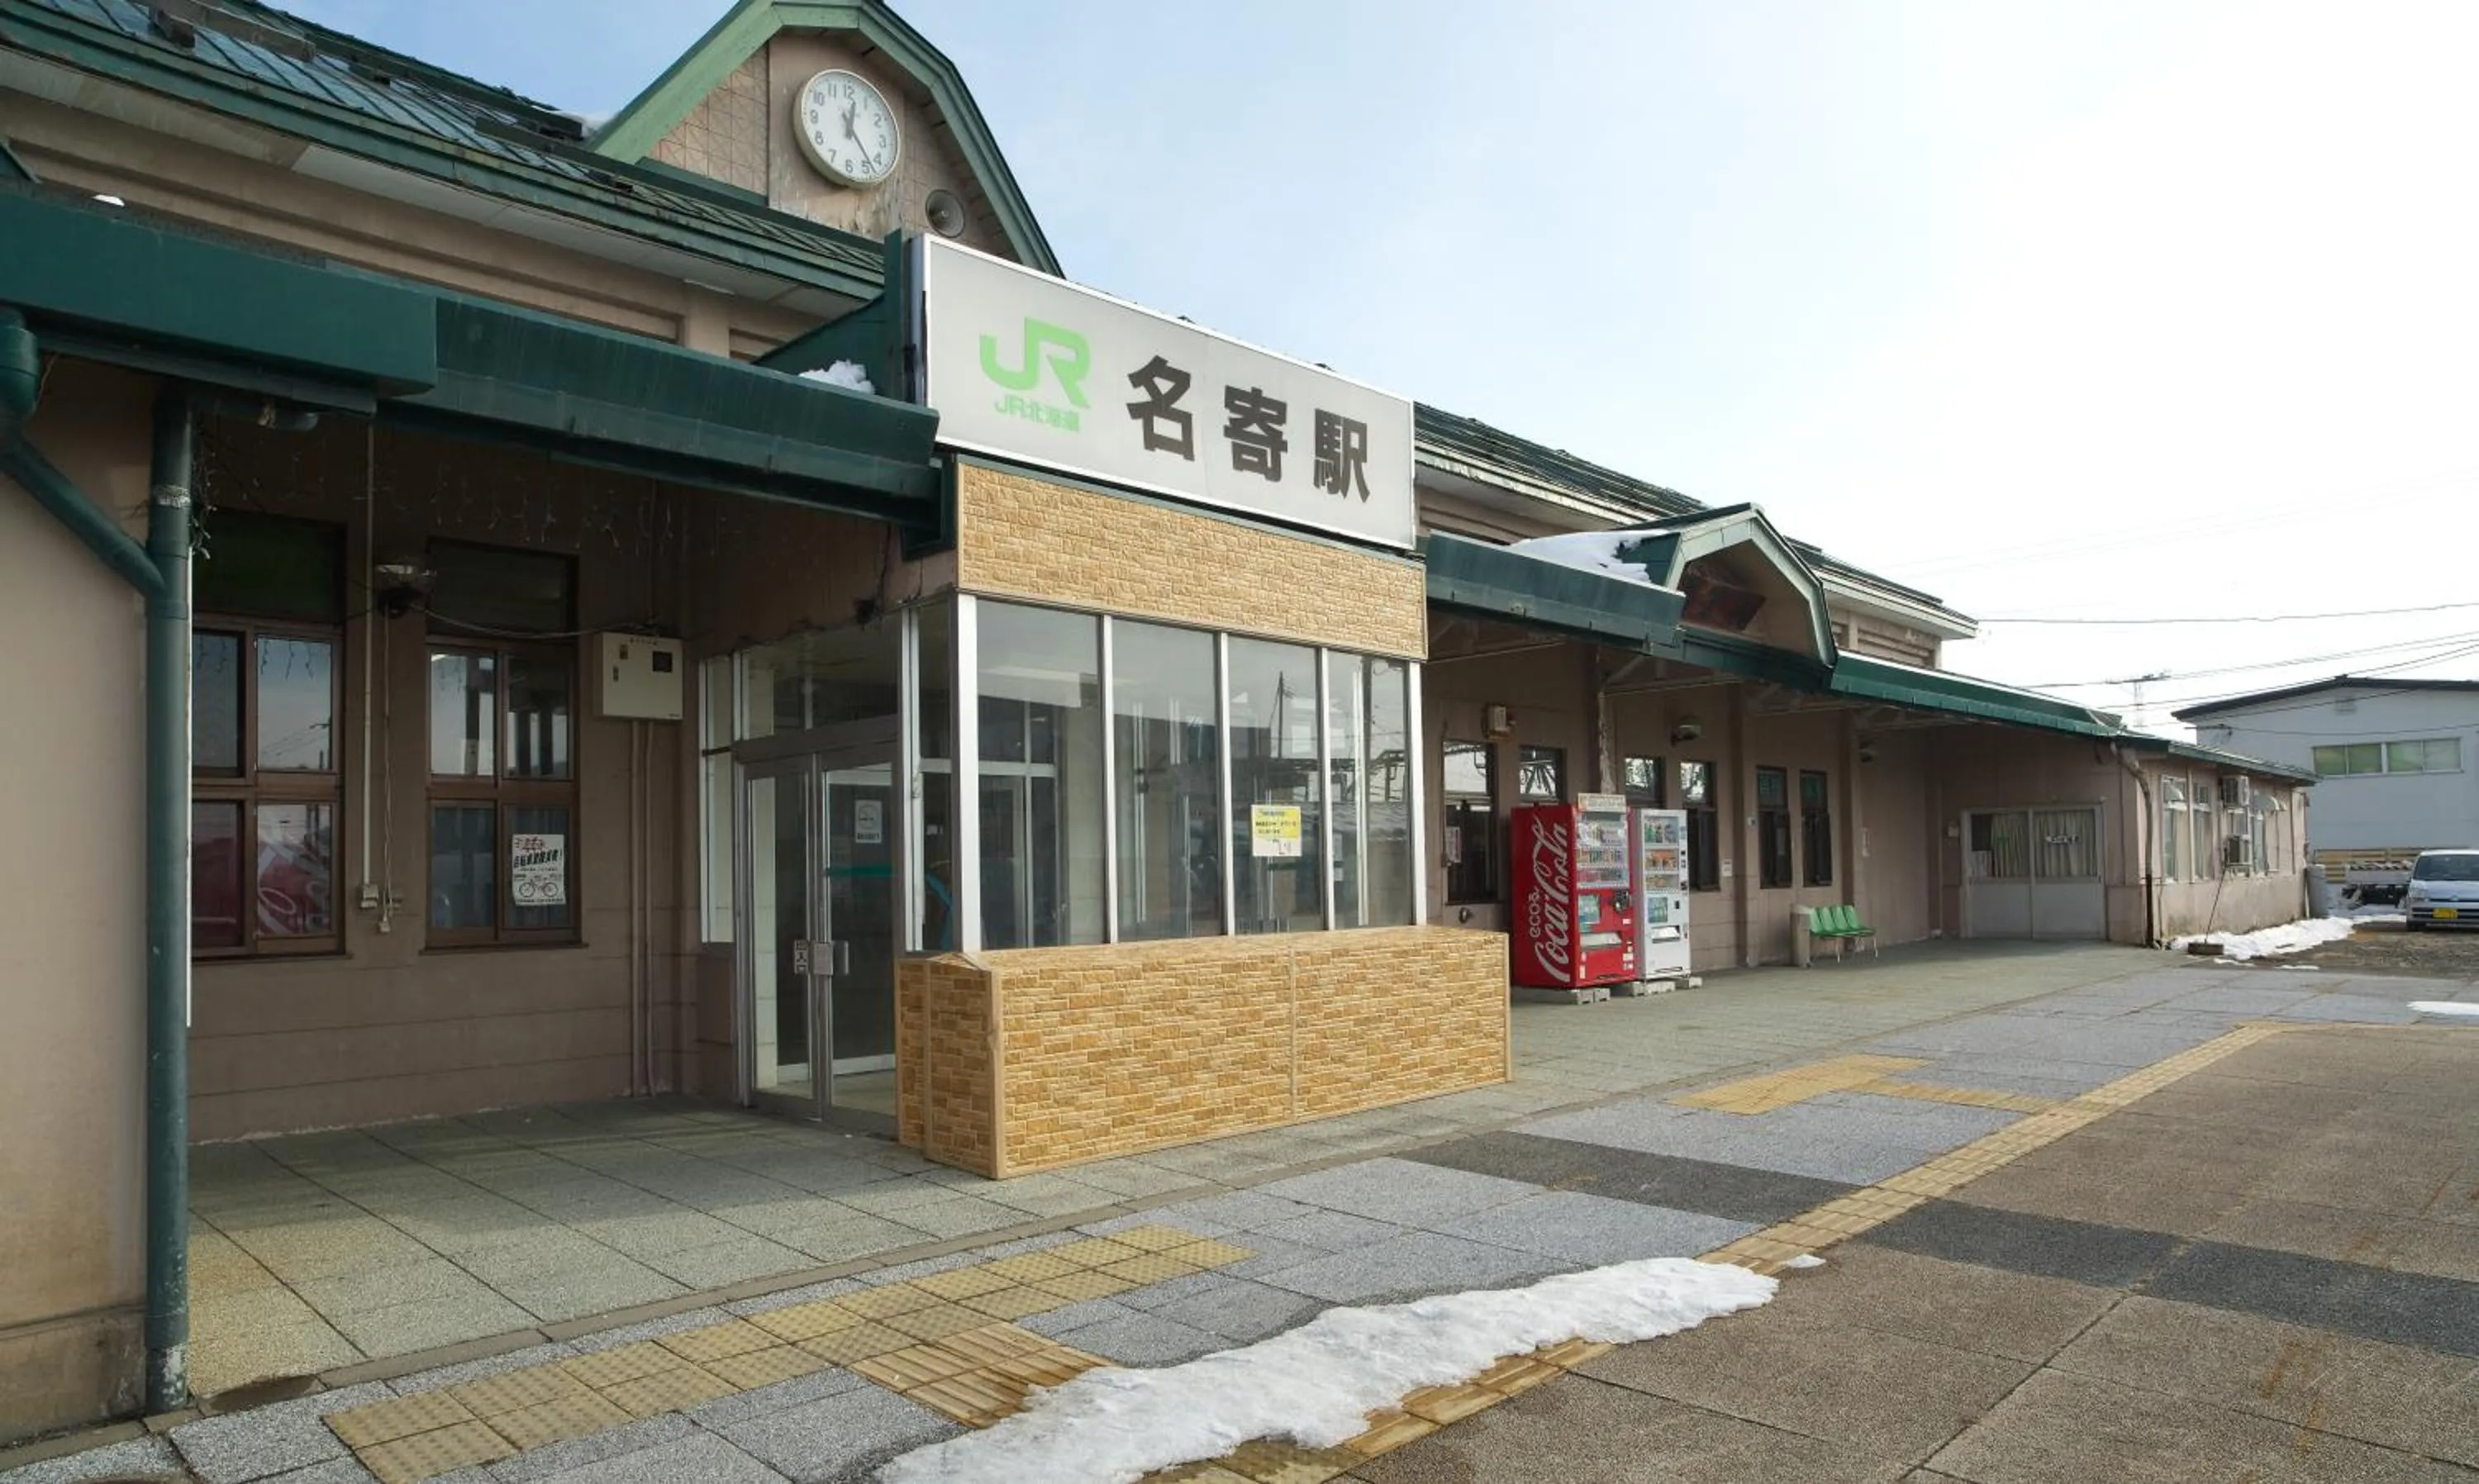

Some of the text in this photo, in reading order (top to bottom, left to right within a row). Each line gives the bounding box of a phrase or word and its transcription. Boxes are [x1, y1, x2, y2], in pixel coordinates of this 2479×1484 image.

[828, 84, 836, 98] 11
[844, 84, 854, 98] 12
[813, 91, 824, 106] 10
[811, 110, 818, 123] 9
[873, 113, 882, 126] 2
[815, 132, 823, 145] 8
[879, 135, 886, 148] 3
[828, 149, 836, 162] 7
[873, 153, 881, 164] 4
[846, 159, 853, 172] 6
[862, 161, 869, 174] 5
[979, 316, 1091, 409] JR
[1125, 355, 1370, 502] 名寄駅
